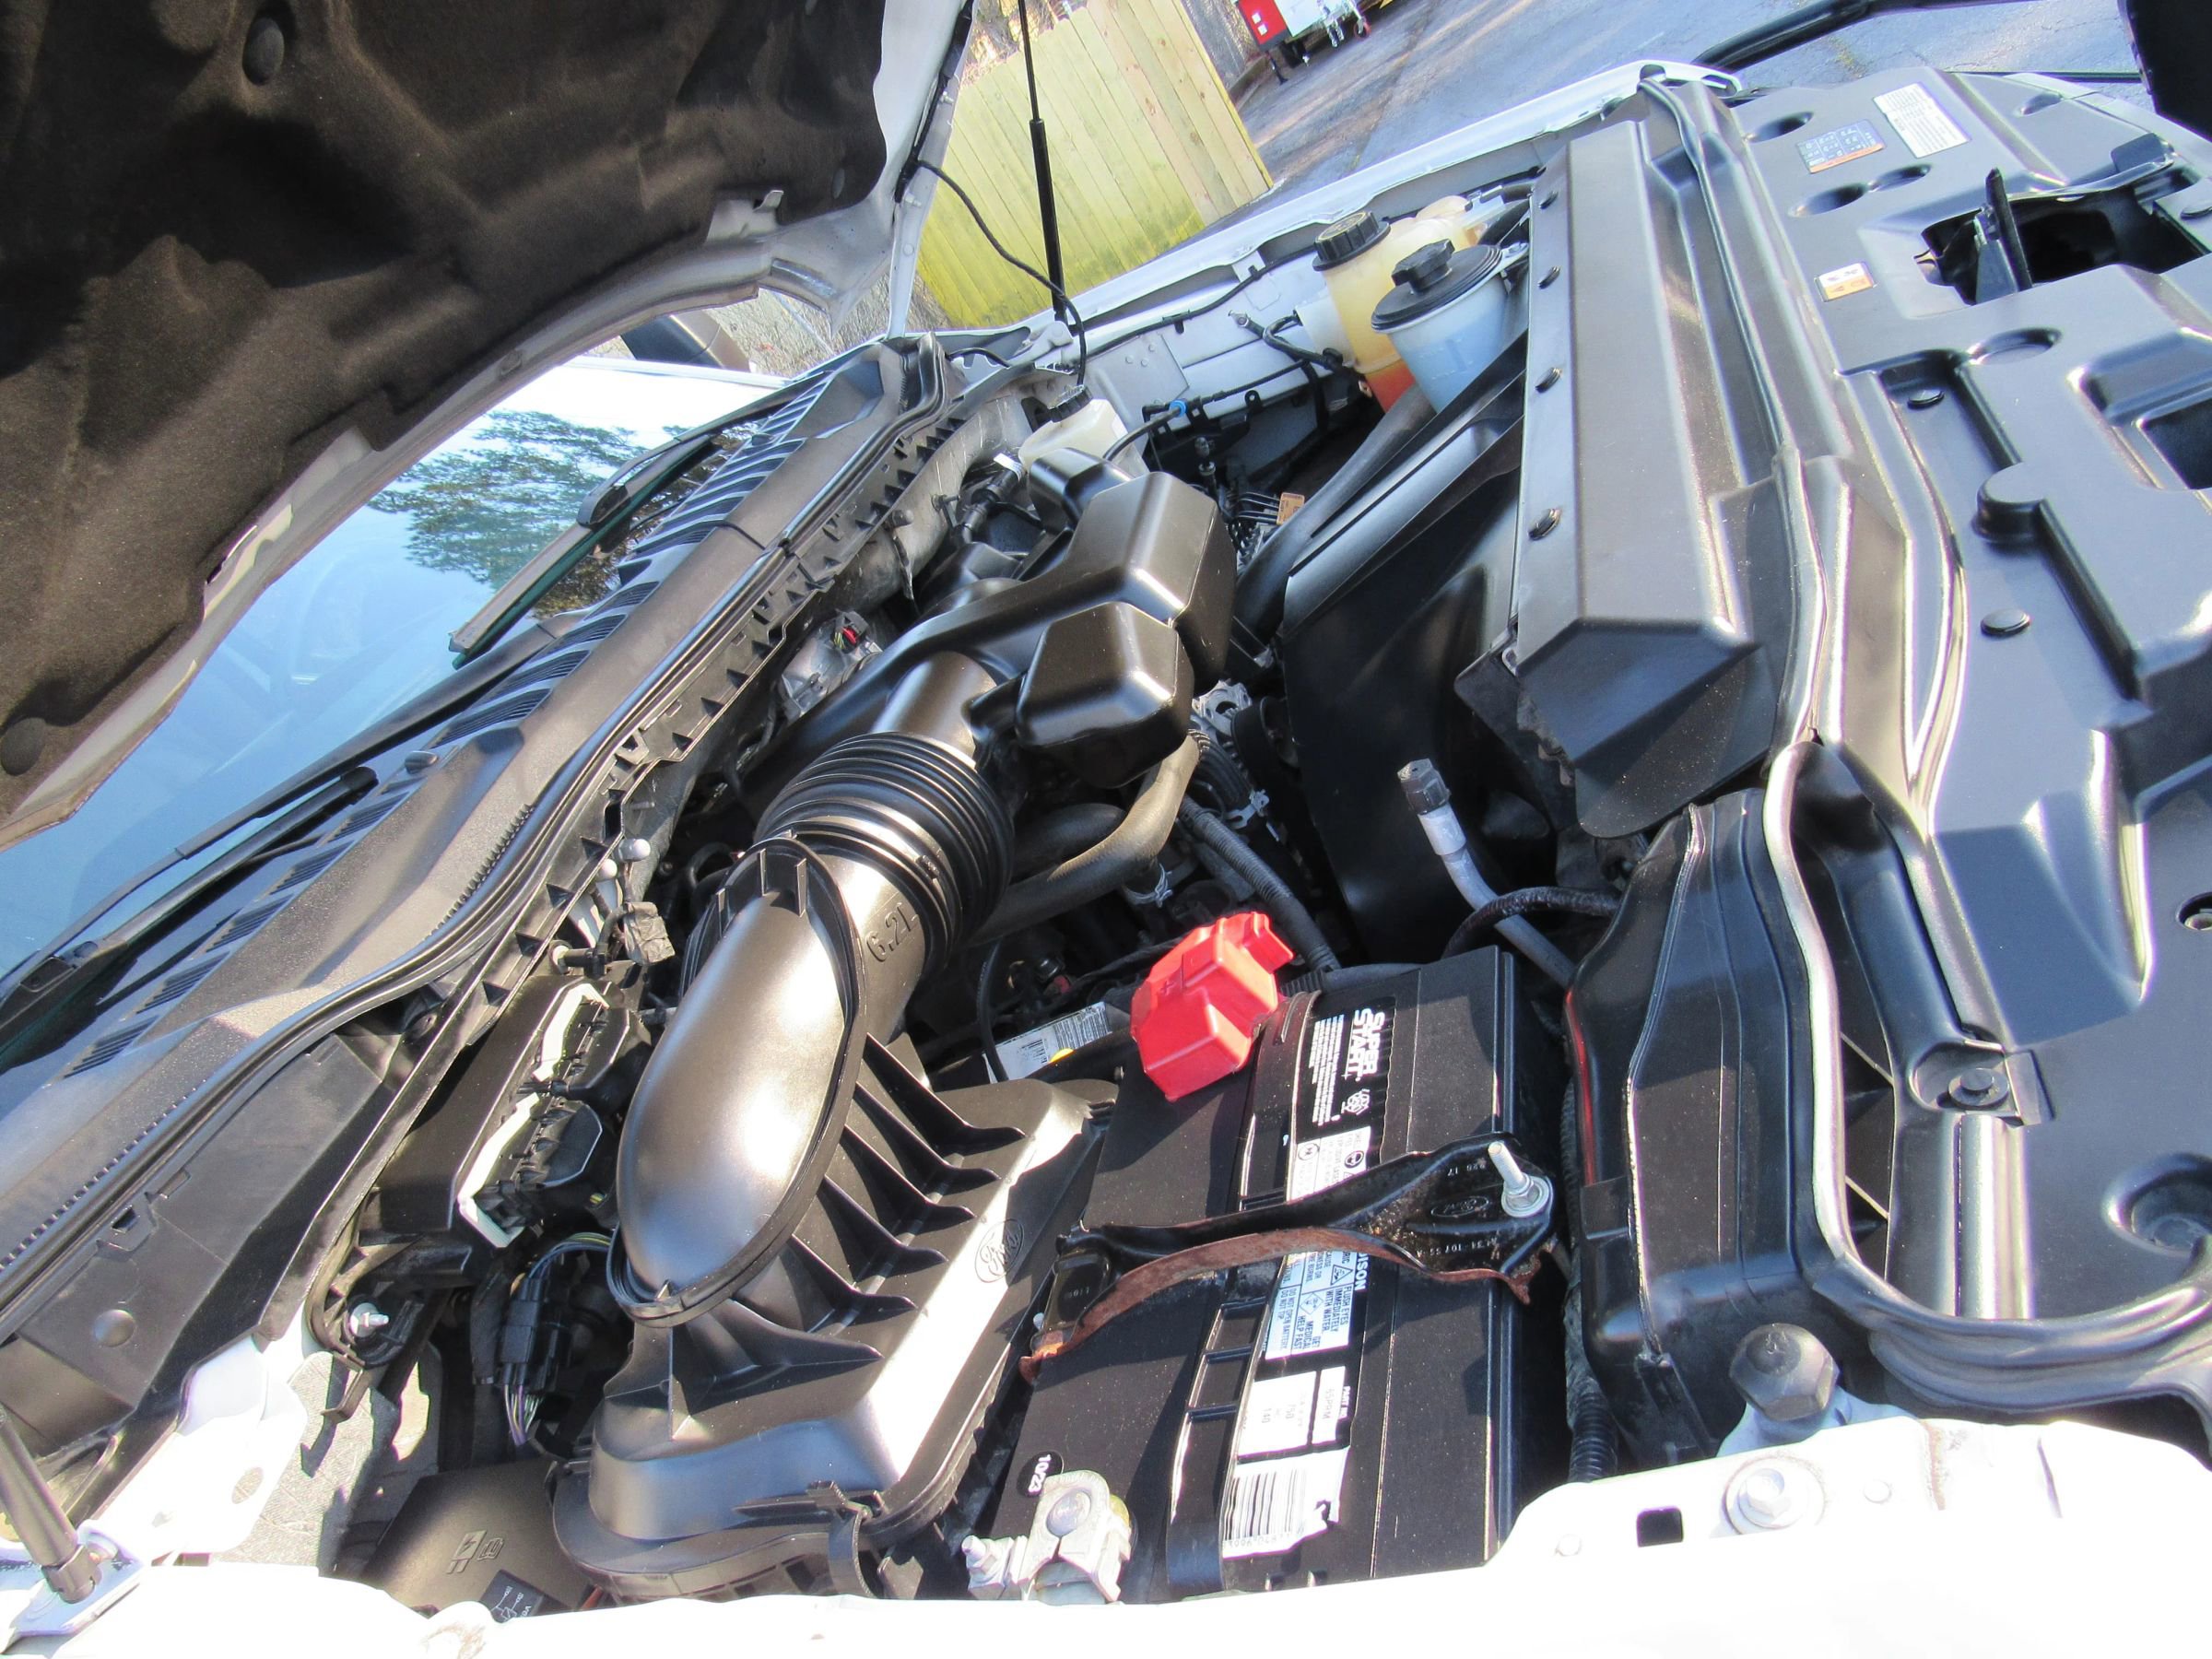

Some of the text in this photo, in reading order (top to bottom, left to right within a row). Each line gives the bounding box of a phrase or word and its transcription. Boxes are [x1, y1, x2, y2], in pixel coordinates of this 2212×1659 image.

[1347, 1008, 1373, 1077] START
[1362, 1011, 1385, 1074] SUPER
[978, 1224, 1021, 1278] Ford
[1278, 1298, 1287, 1309] NOT
[1286, 1297, 1296, 1307] NOT
[1324, 1289, 1334, 1306] WITH
[1340, 1286, 1351, 1325] FLUSH EYES
[1283, 1309, 1293, 1324] OPEN
[1331, 1288, 1343, 1332] IMMEDIATELY
[1297, 1314, 1306, 1332] HELP
[1303, 1321, 1313, 1349] MEDICAL
[1312, 1335, 1321, 1347] GET
